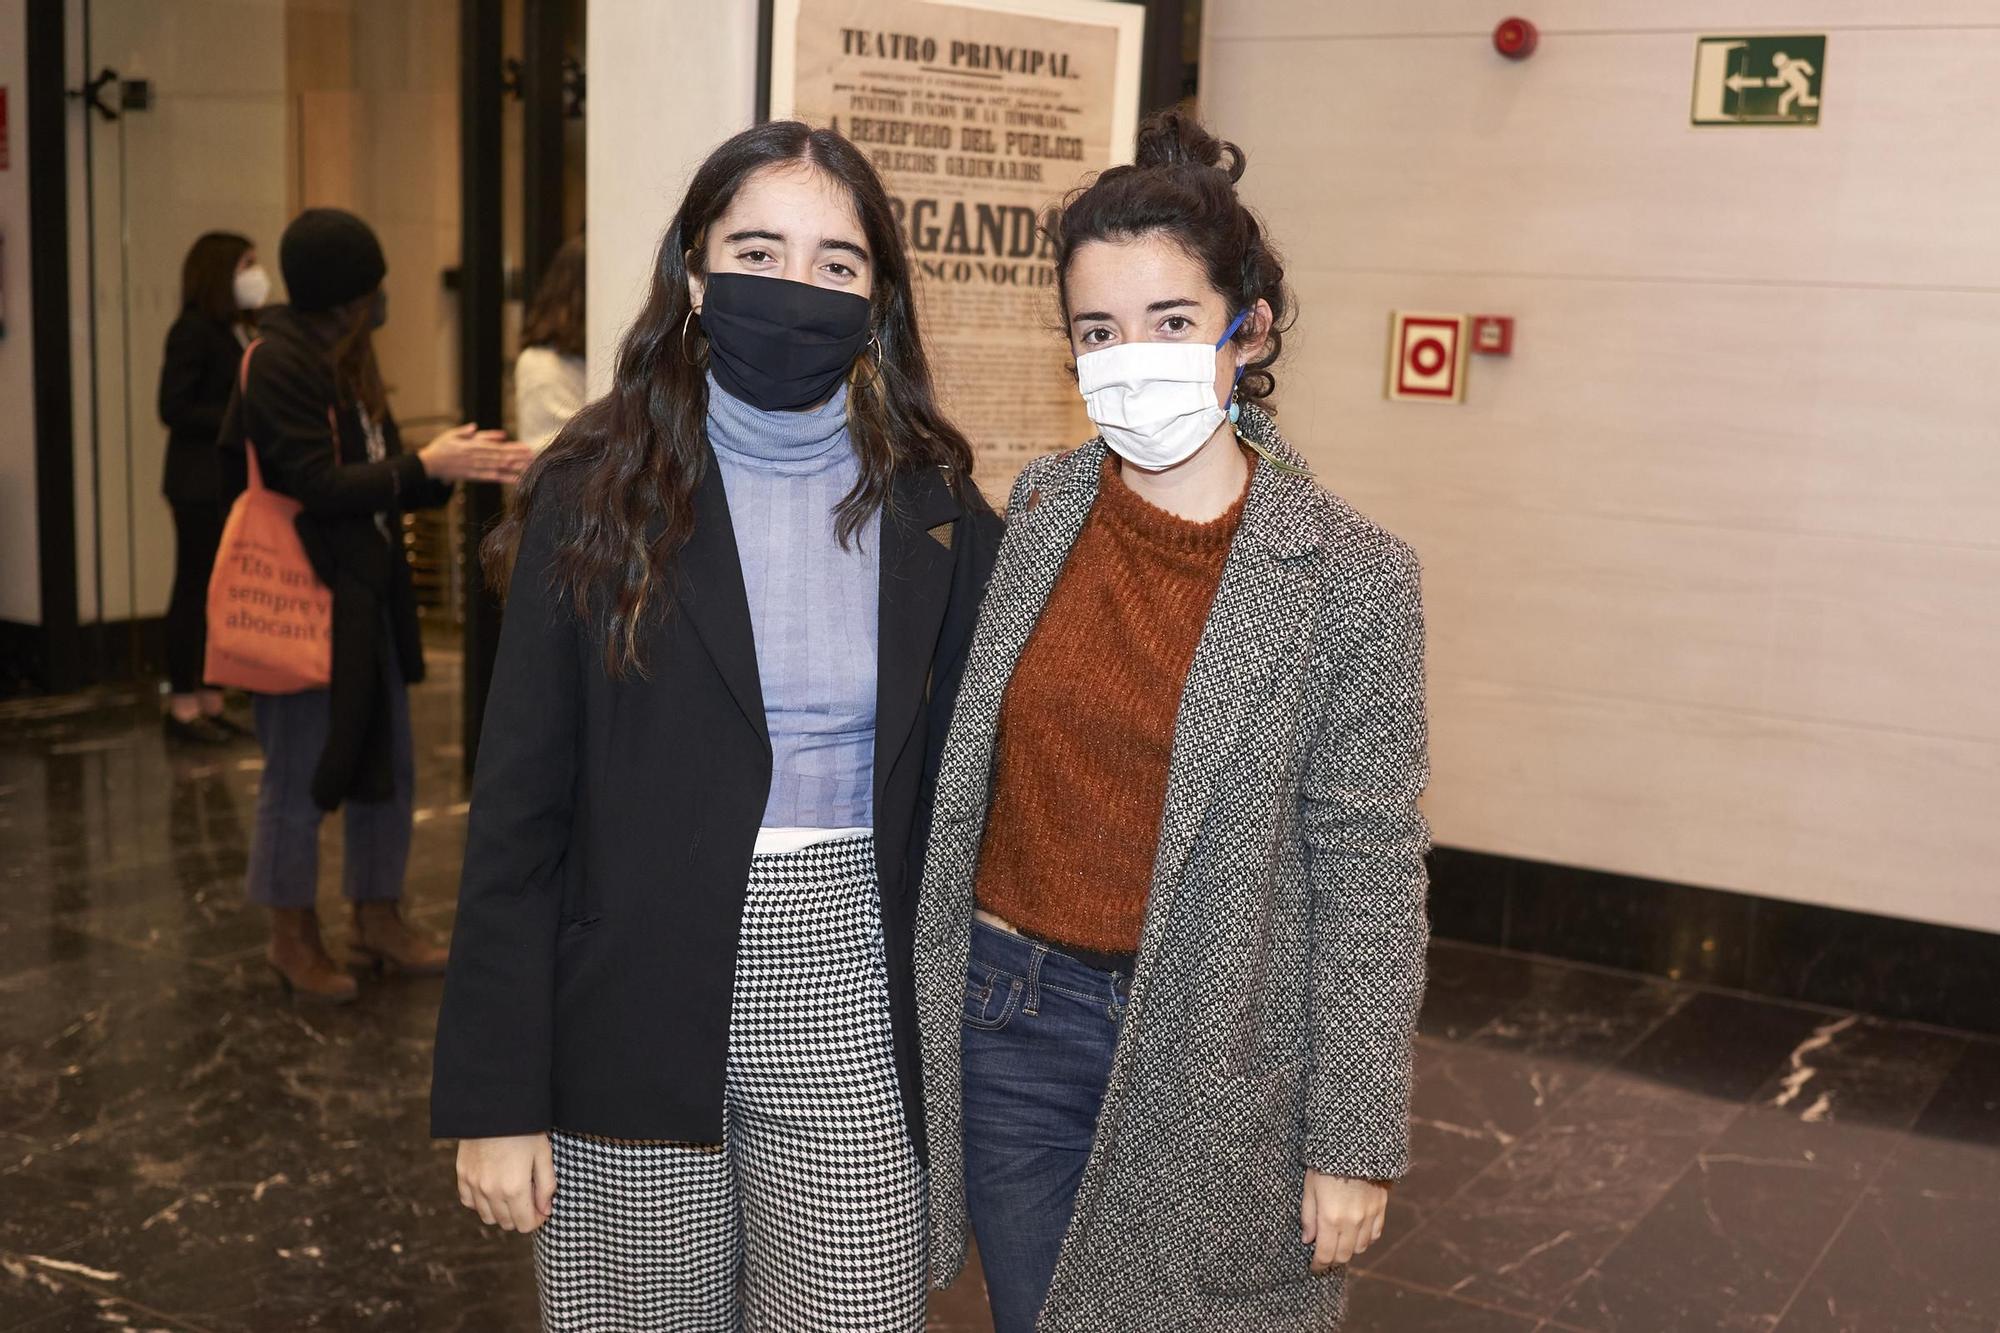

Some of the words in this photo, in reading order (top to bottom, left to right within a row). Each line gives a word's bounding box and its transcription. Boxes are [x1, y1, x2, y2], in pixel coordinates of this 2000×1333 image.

[841, 29, 937, 62] TEATRO
[849, 116, 953, 150] BENEFICIO
[961, 127, 996, 154] DEL
[229, 585, 311, 615] sempre
[227, 608, 317, 640] abocant
